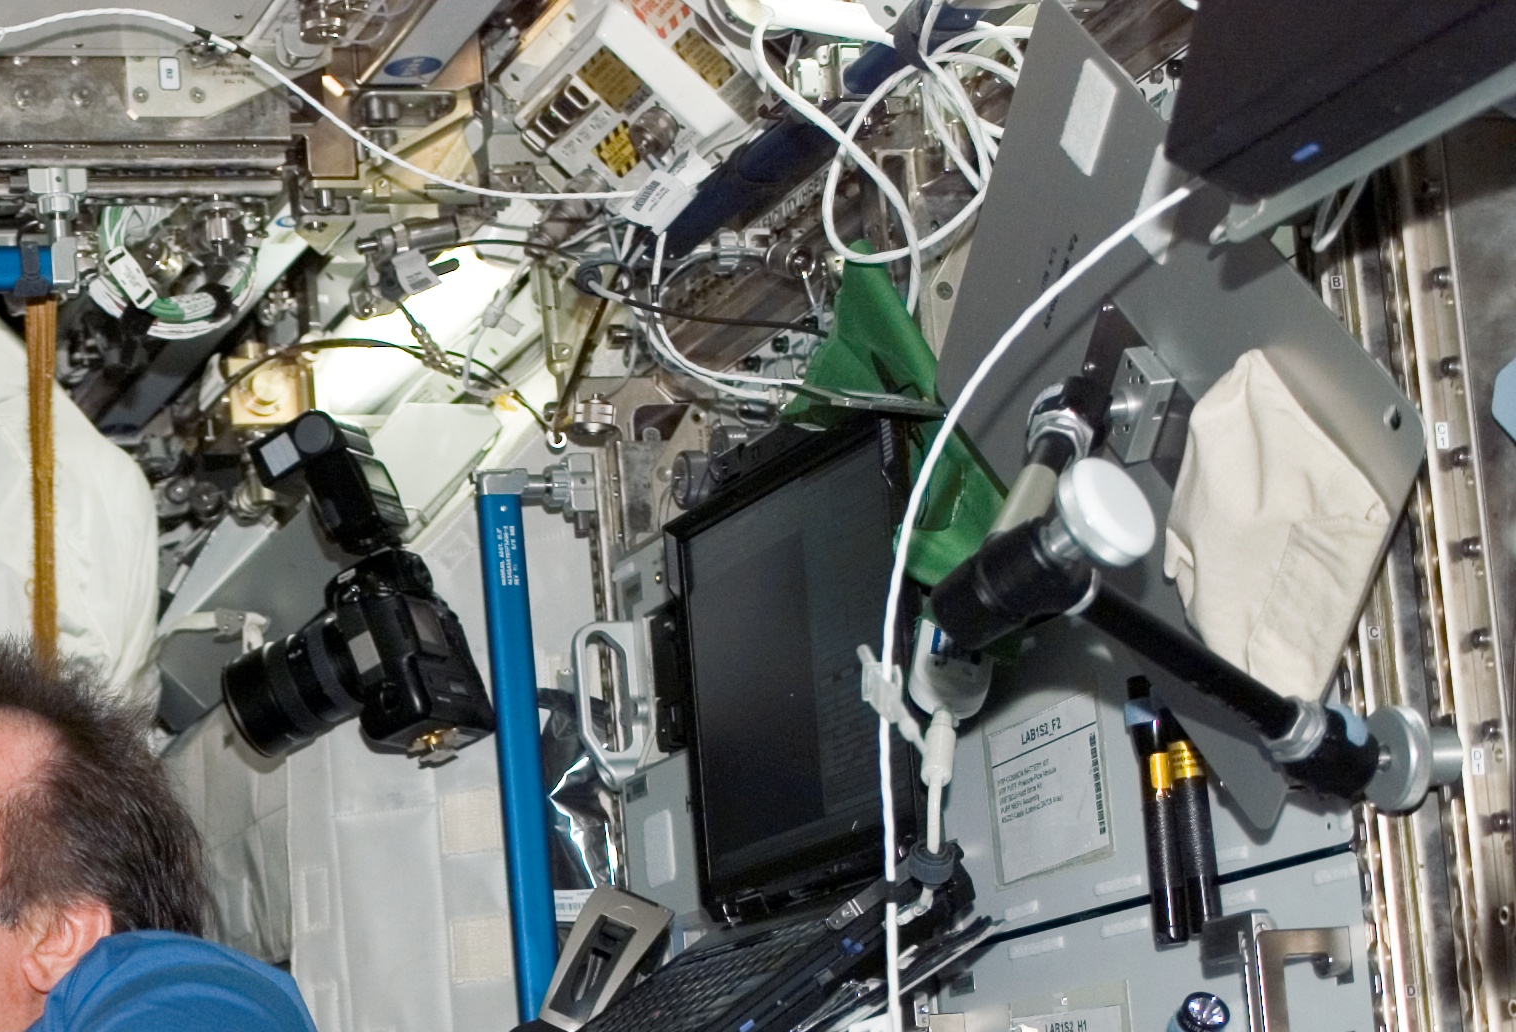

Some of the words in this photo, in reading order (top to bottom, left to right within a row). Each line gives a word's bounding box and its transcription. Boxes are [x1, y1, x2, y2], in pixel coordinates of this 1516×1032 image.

[1437, 424, 1447, 435] C
[1369, 628, 1379, 639] C
[1021, 717, 1062, 746] LAB1S2_F2
[1473, 750, 1482, 762] D
[1406, 986, 1416, 997] D
